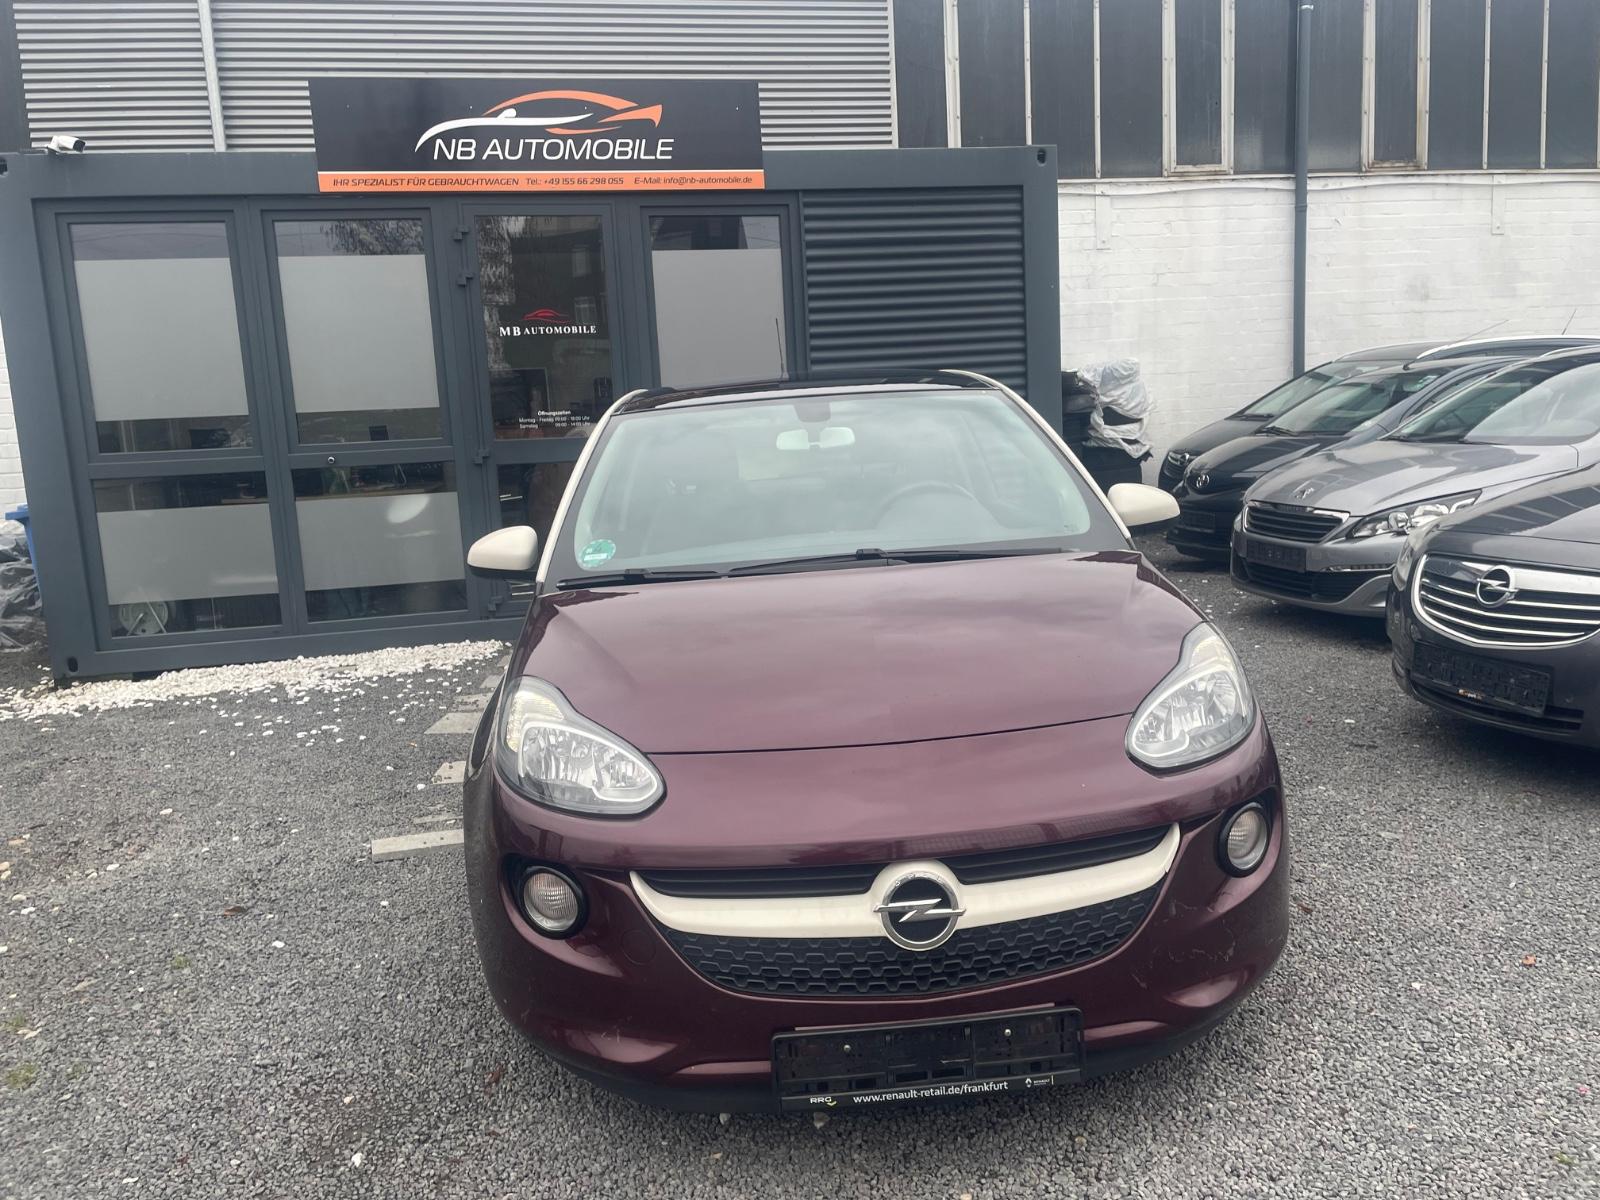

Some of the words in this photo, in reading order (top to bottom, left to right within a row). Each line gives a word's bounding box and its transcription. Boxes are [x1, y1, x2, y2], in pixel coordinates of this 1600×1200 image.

[433, 138, 476, 160] NB
[482, 138, 675, 160] AUTOMOBILE
[333, 178, 350, 187] IHR
[351, 178, 406, 187] SPEZIALIST
[407, 176, 426, 186] FÜR
[427, 177, 520, 186] GEBRAUCHTWAGEN
[589, 177, 606, 185] 298
[607, 177, 624, 185] 055
[663, 176, 753, 186] info@nb-automobile.de
[499, 326, 521, 337] MB
[523, 325, 597, 335] AUTOMOBILE
[853, 1081, 1009, 1104] www.renault-retail.de/frankfurt
